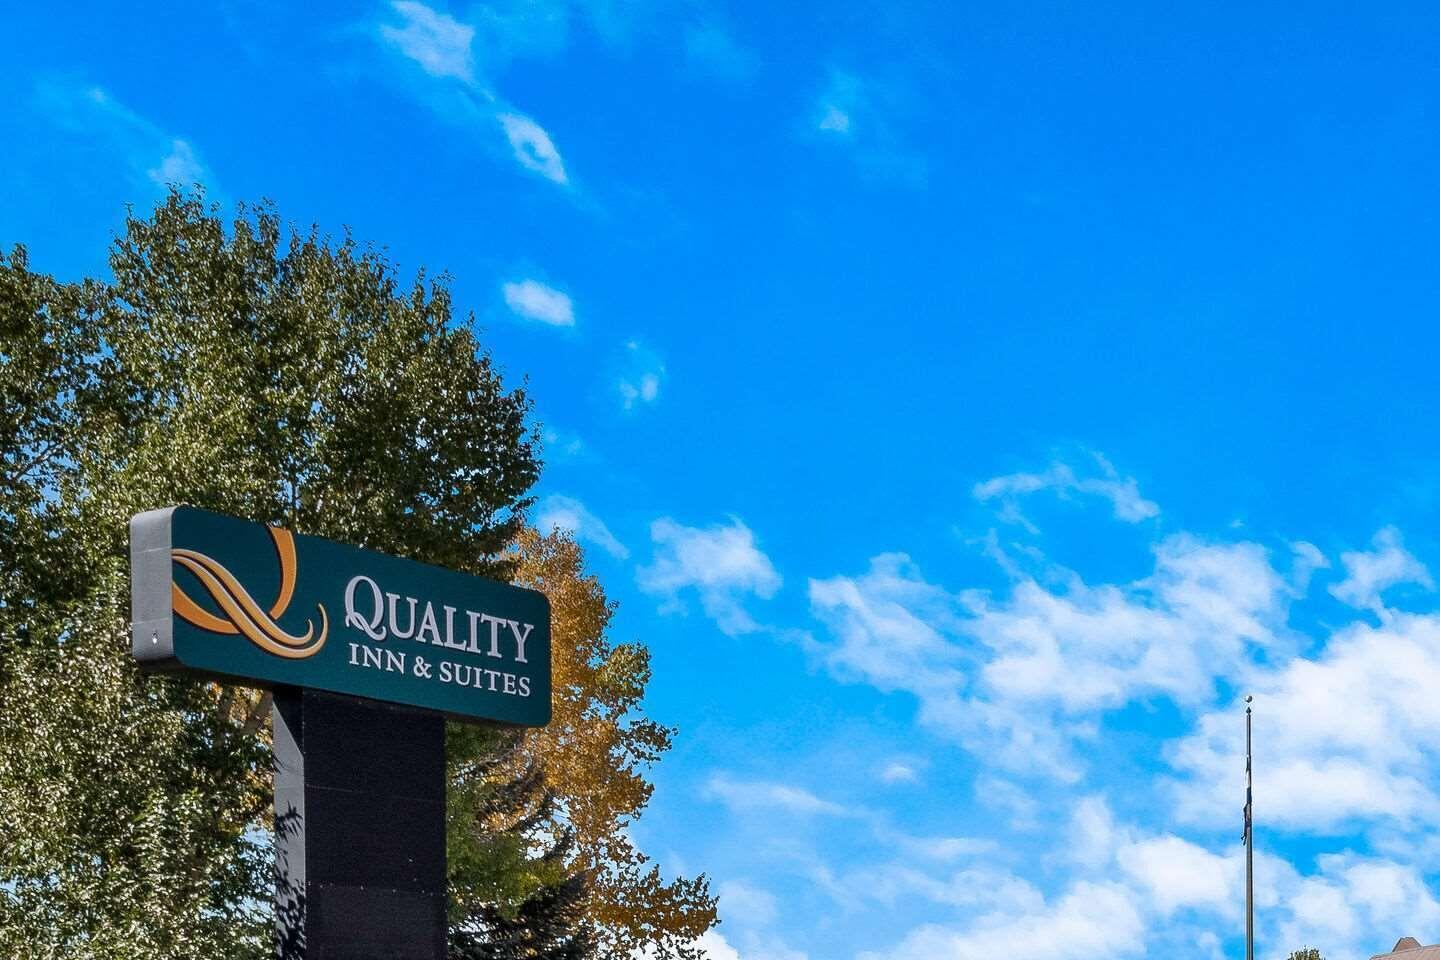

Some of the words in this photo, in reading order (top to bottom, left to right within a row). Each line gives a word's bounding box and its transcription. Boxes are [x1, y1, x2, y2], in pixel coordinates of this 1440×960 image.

[344, 575, 535, 664] QUALITY
[348, 642, 406, 675] INN
[413, 655, 433, 679] &
[439, 661, 532, 697] SUITES
